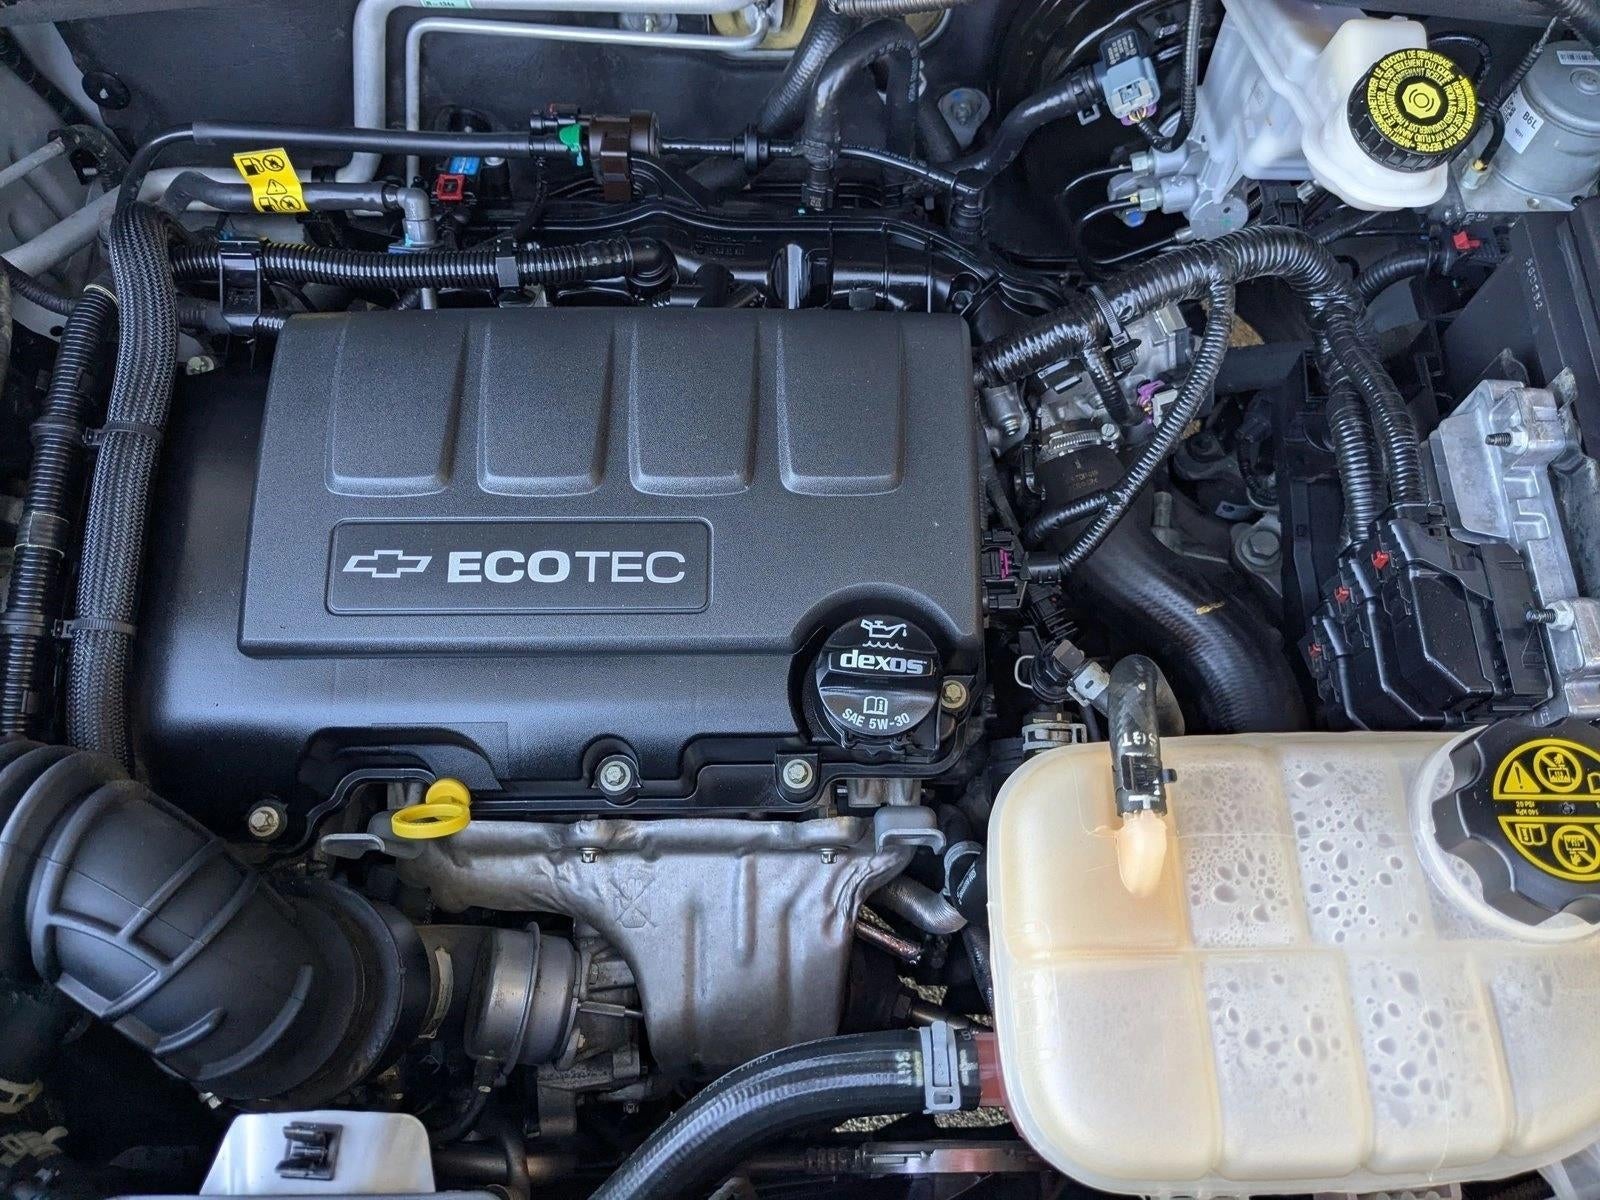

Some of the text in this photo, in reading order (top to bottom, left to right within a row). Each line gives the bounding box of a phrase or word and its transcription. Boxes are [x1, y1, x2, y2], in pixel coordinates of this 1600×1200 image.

[1372, 66, 1384, 77] LE
[1378, 51, 1406, 70] BOUCHON
[1405, 50, 1416, 58] DE
[1384, 116, 1395, 126] DE
[1451, 113, 1464, 127] USE
[1523, 111, 1536, 130] B6L
[1416, 141, 1443, 151] BEFORE
[1441, 135, 1458, 148] CAP
[447, 550, 686, 584] ECOTEC
[842, 708, 910, 730] SAE 5W-30
[1515, 800, 1524, 808] 20
